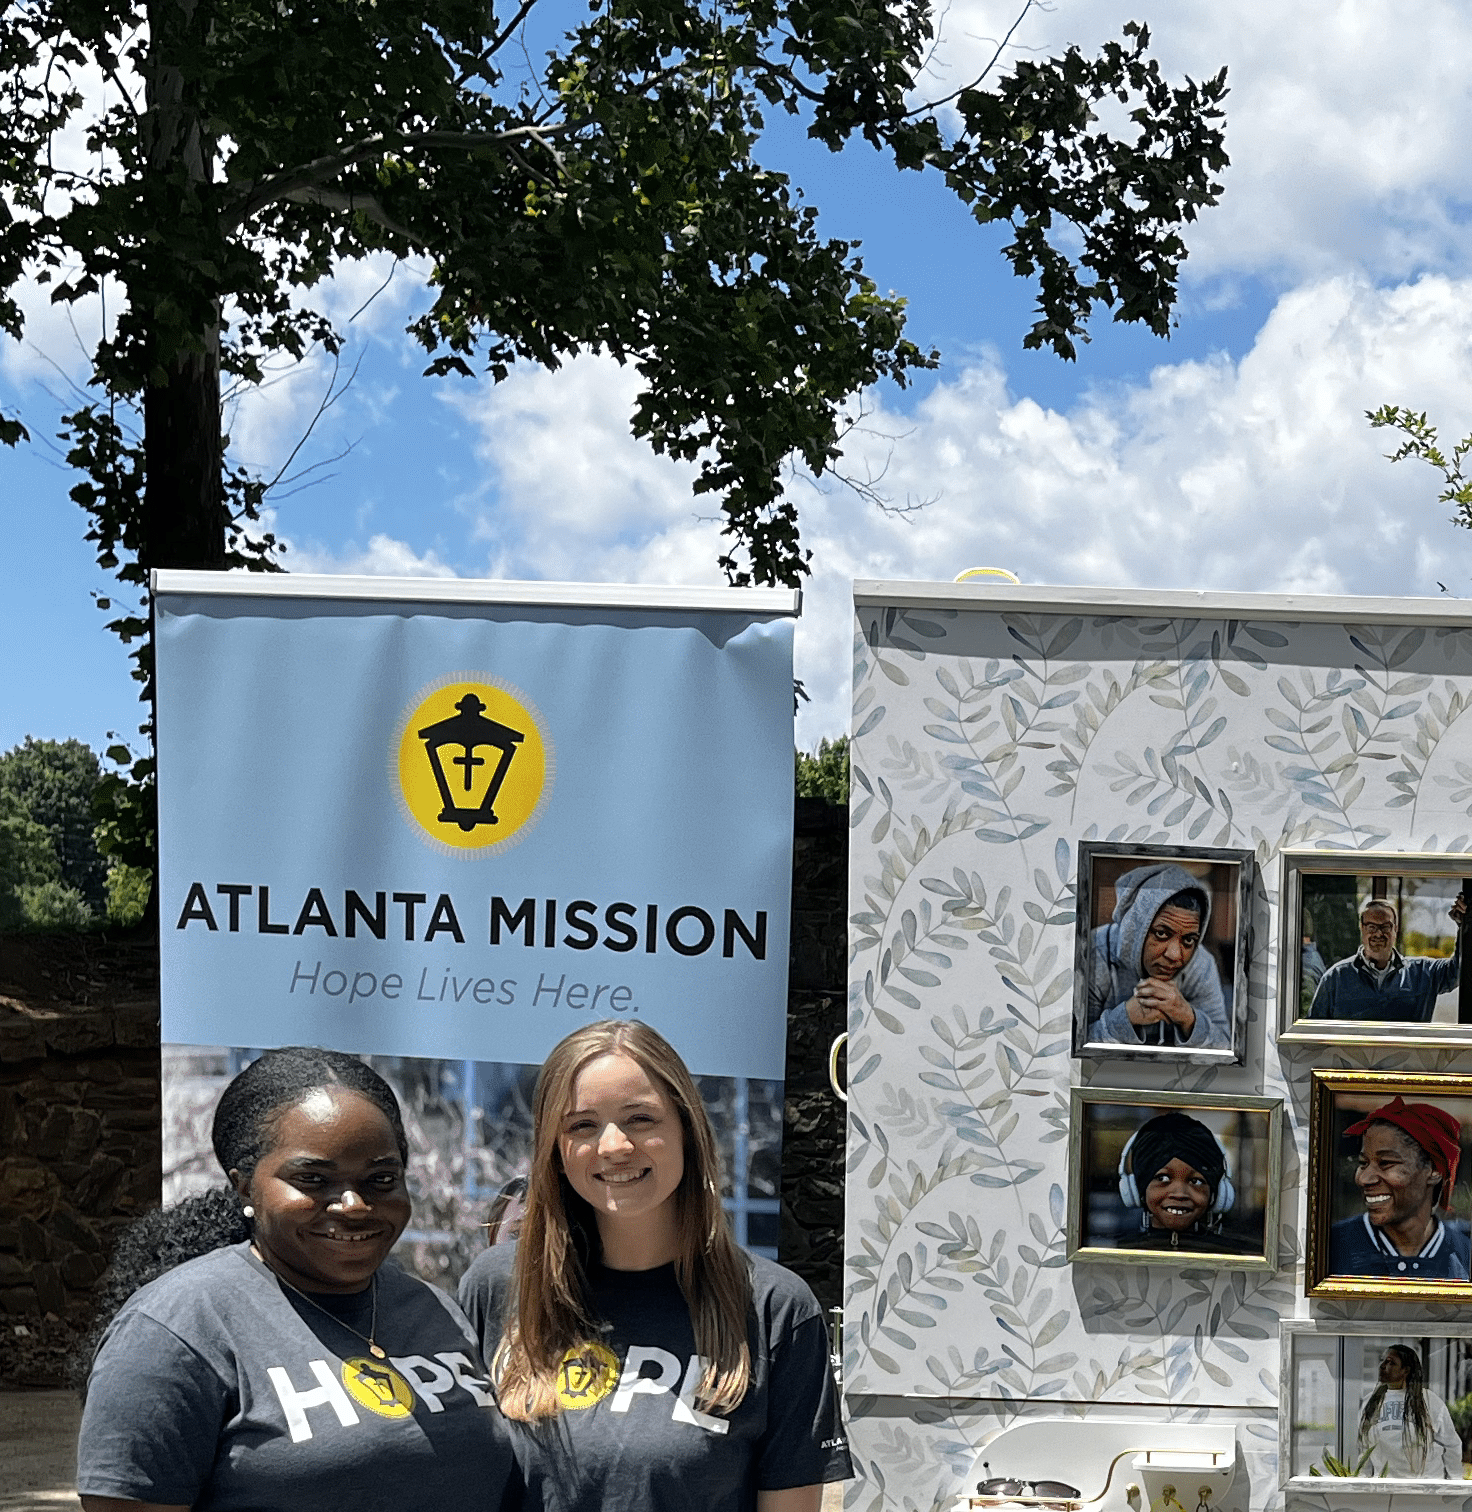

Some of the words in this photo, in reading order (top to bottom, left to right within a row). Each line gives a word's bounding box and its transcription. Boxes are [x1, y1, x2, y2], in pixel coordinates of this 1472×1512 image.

[176, 882, 465, 943] ATLANTA
[490, 896, 767, 960] MISSION
[289, 960, 404, 1003] Hope
[416, 967, 516, 1006] Lives
[532, 972, 641, 1013] Here.
